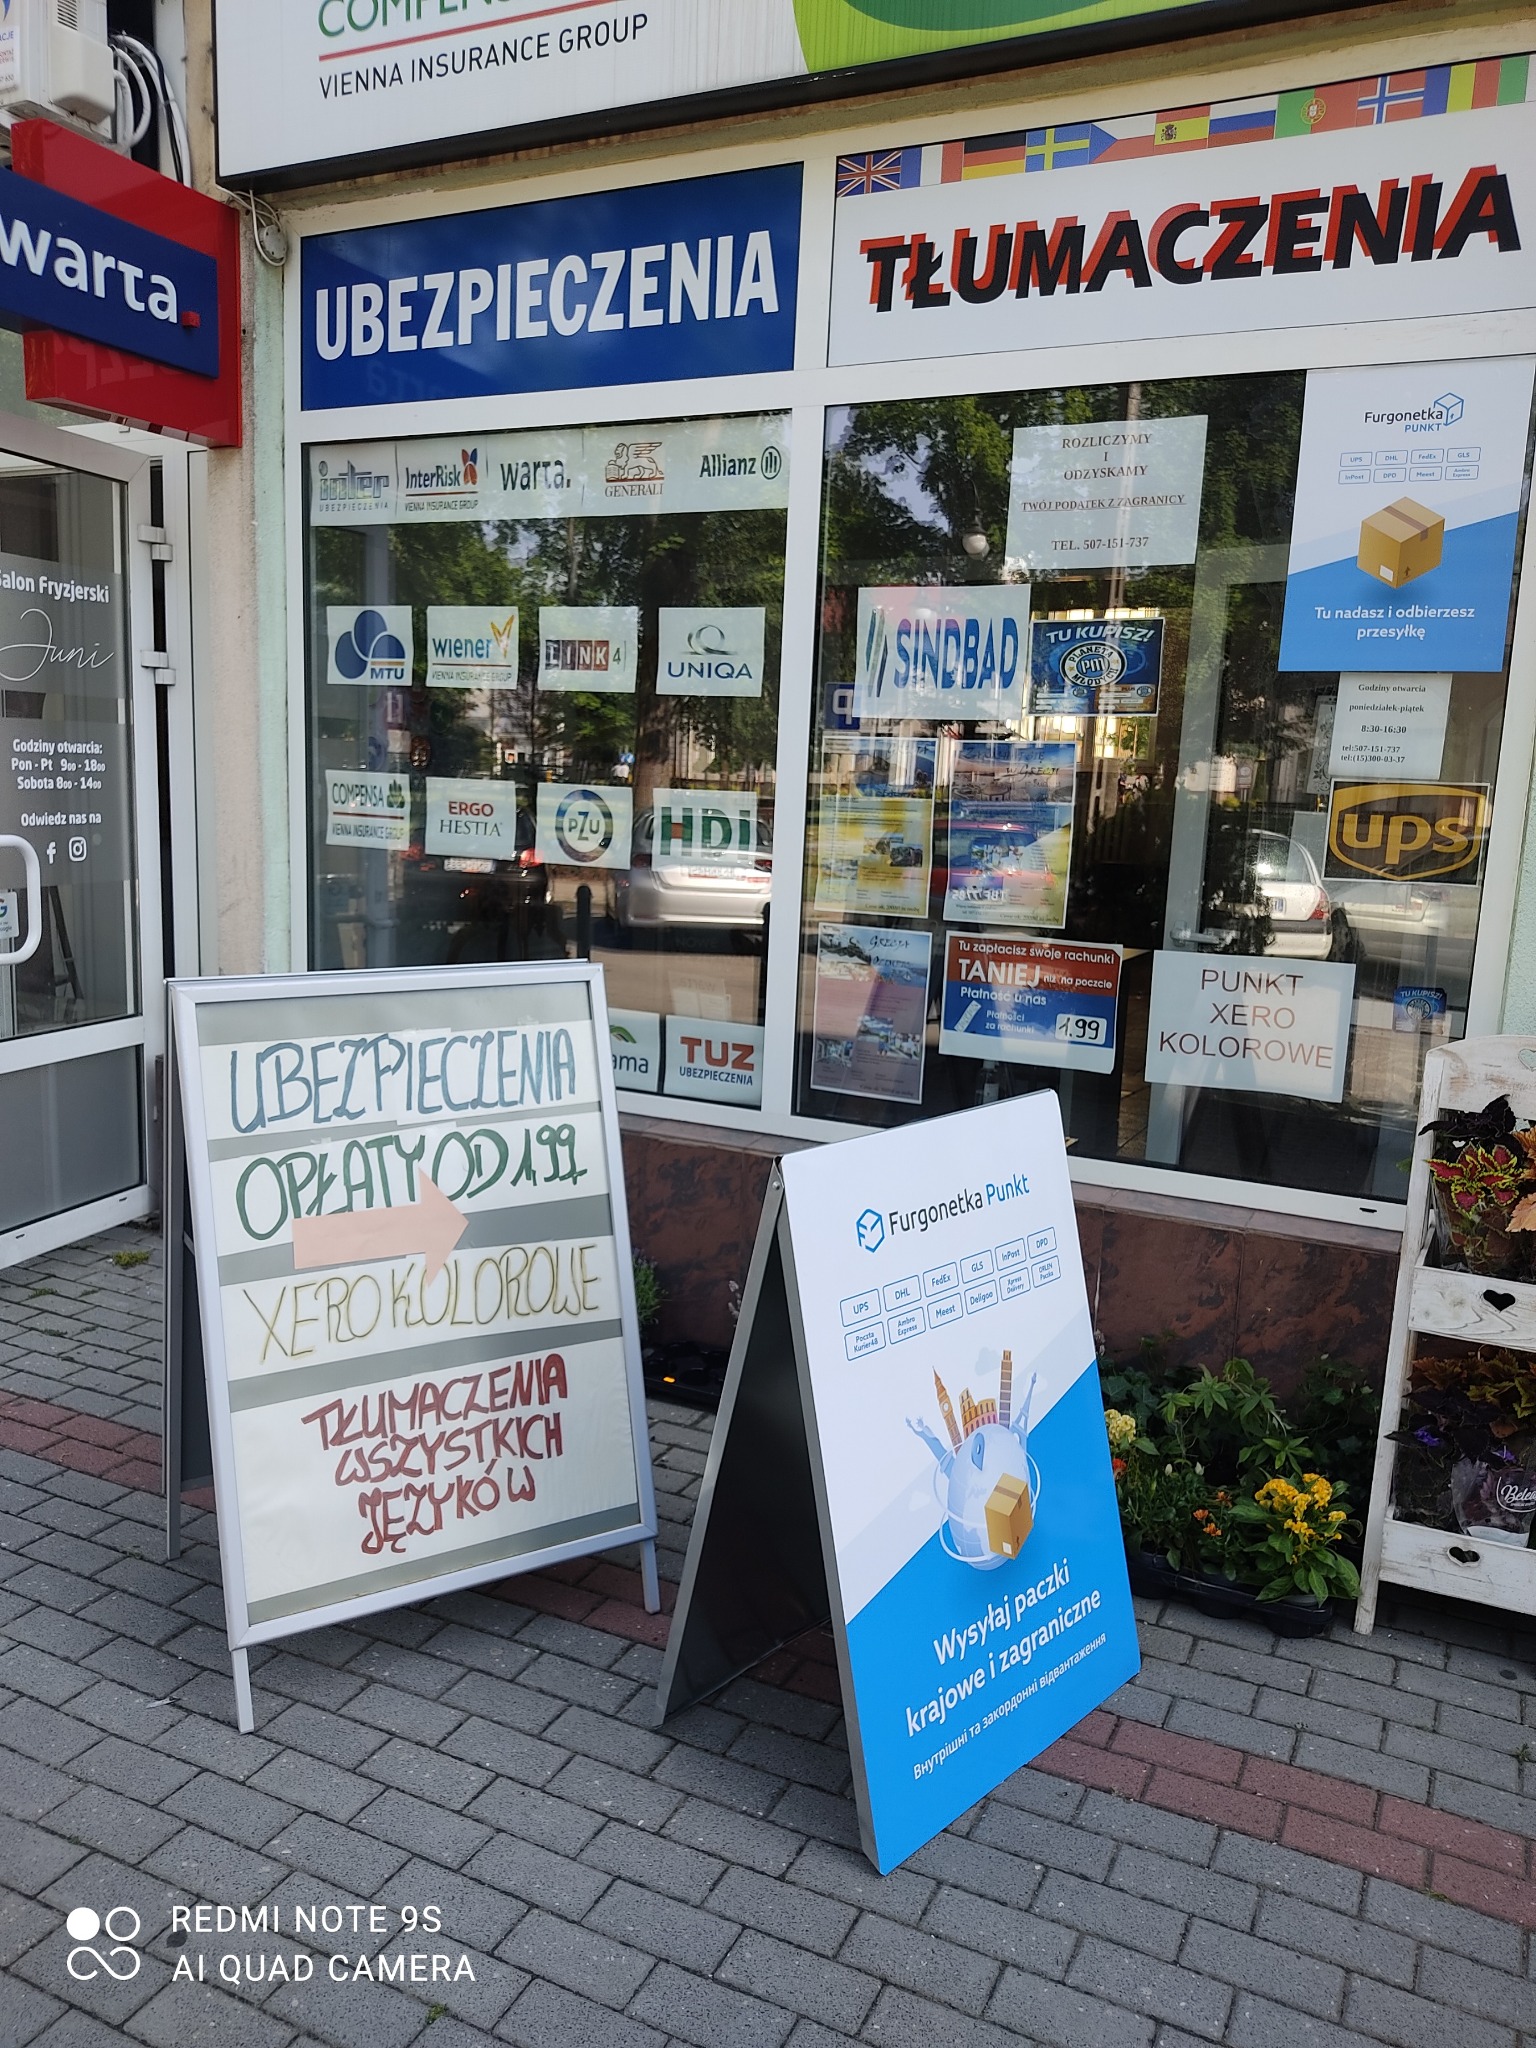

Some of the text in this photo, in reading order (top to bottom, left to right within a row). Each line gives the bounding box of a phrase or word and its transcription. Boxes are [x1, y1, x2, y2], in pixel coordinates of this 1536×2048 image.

[319, 63, 403, 99] VIENNA
[412, 32, 550, 83] INSURANCE
[559, 13, 648, 54] GROUP
[860, 164, 1521, 313] TŁUMACZENIA
[315, 230, 780, 361] UBEZPIECZENIA
[1364, 407, 1443, 425] Furgonetka
[1404, 423, 1442, 433] PUNKT
[1062, 434, 1152, 449] ROZLICZYMY
[700, 453, 756, 478] Allianz
[1104, 451, 1108, 461] I
[318, 460, 389, 500] inter
[405, 464, 461, 489] InterRisk
[1063, 464, 1148, 481] ODZYSKAMY
[604, 482, 664, 498] GENERALI
[1055, 498, 1105, 511] PODATEK
[1052, 536, 1149, 551] TEL. 507-151-737
[0, 570, 109, 603] alon Fryzjerski
[1315, 605, 1475, 619] Tu nadasz i odbierzesz
[1046, 625, 1155, 644] TU KUPISZ!
[1356, 624, 1426, 641] przesyłkę
[432, 638, 493, 659] wiener
[893, 617, 1019, 690] SINDBAD
[1068, 645, 1115, 663] PLANETA
[370, 667, 404, 680] MTU
[667, 661, 753, 679] UNIQA
[1358, 683, 1426, 693] Godziny otwarcia
[1361, 724, 1407, 734] 8:30-16:30
[13, 739, 103, 756] Godziny otwarcia:
[11, 757, 32, 771] Pon
[40, 758, 53, 771] Pt
[17, 776, 54, 790] Sobota
[332, 783, 384, 808] COMPENSA
[20, 812, 102, 827] Odwiedz nas na
[448, 801, 494, 817] ERGO
[440, 819, 501, 837] HESTIA
[568, 811, 600, 841] PZU
[660, 807, 751, 860] HDI
[1342, 813, 1469, 865] ups
[959, 940, 970, 951] Tu
[973, 942, 1027, 956] zapłacisz
[1064, 949, 1115, 965] rachunki
[958, 958, 1041, 988] TANIEJ
[1060, 976, 1073, 985] na
[1075, 977, 1113, 989] poczcie
[1201, 968, 1303, 996] PUNKT
[960, 986, 1047, 1006] Płatność u nas
[1209, 1002, 1296, 1029] XERO
[985, 1022, 1035, 1034] za rachunki
[1058, 1016, 1100, 1040] 1.99
[680, 1036, 754, 1071] TUZ
[1158, 1031, 1334, 1069] KOLOROWE
[230, 1028, 575, 1133] UBEZPIECZENIA
[679, 1066, 753, 1086] UBEZPIECZENIA
[235, 1132, 427, 1240] OPŁATY
[431, 1128, 509, 1201] OD
[888, 1173, 1030, 1235] Furgonetka Punkt
[853, 1237, 1049, 1315] UPS DHL FedEx GLS InPost DPD
[243, 1243, 602, 1365] XERO KOLOROWE
[935, 1291, 994, 1318] Meest Deligoo
[855, 1331, 875, 1344] Poczta
[897, 1324, 918, 1337] Express
[853, 1337, 879, 1353] Kurier48
[335, 1411, 564, 1487] WSZYSTKICH
[358, 1457, 537, 1555] JĘZYKÓW
[933, 1557, 1071, 1666] Wysyłaj paczki
[905, 1589, 1101, 1738] krajowe i zagraniczne
[913, 1632, 1106, 1780] Внутрішні та закордонні відвантаження
